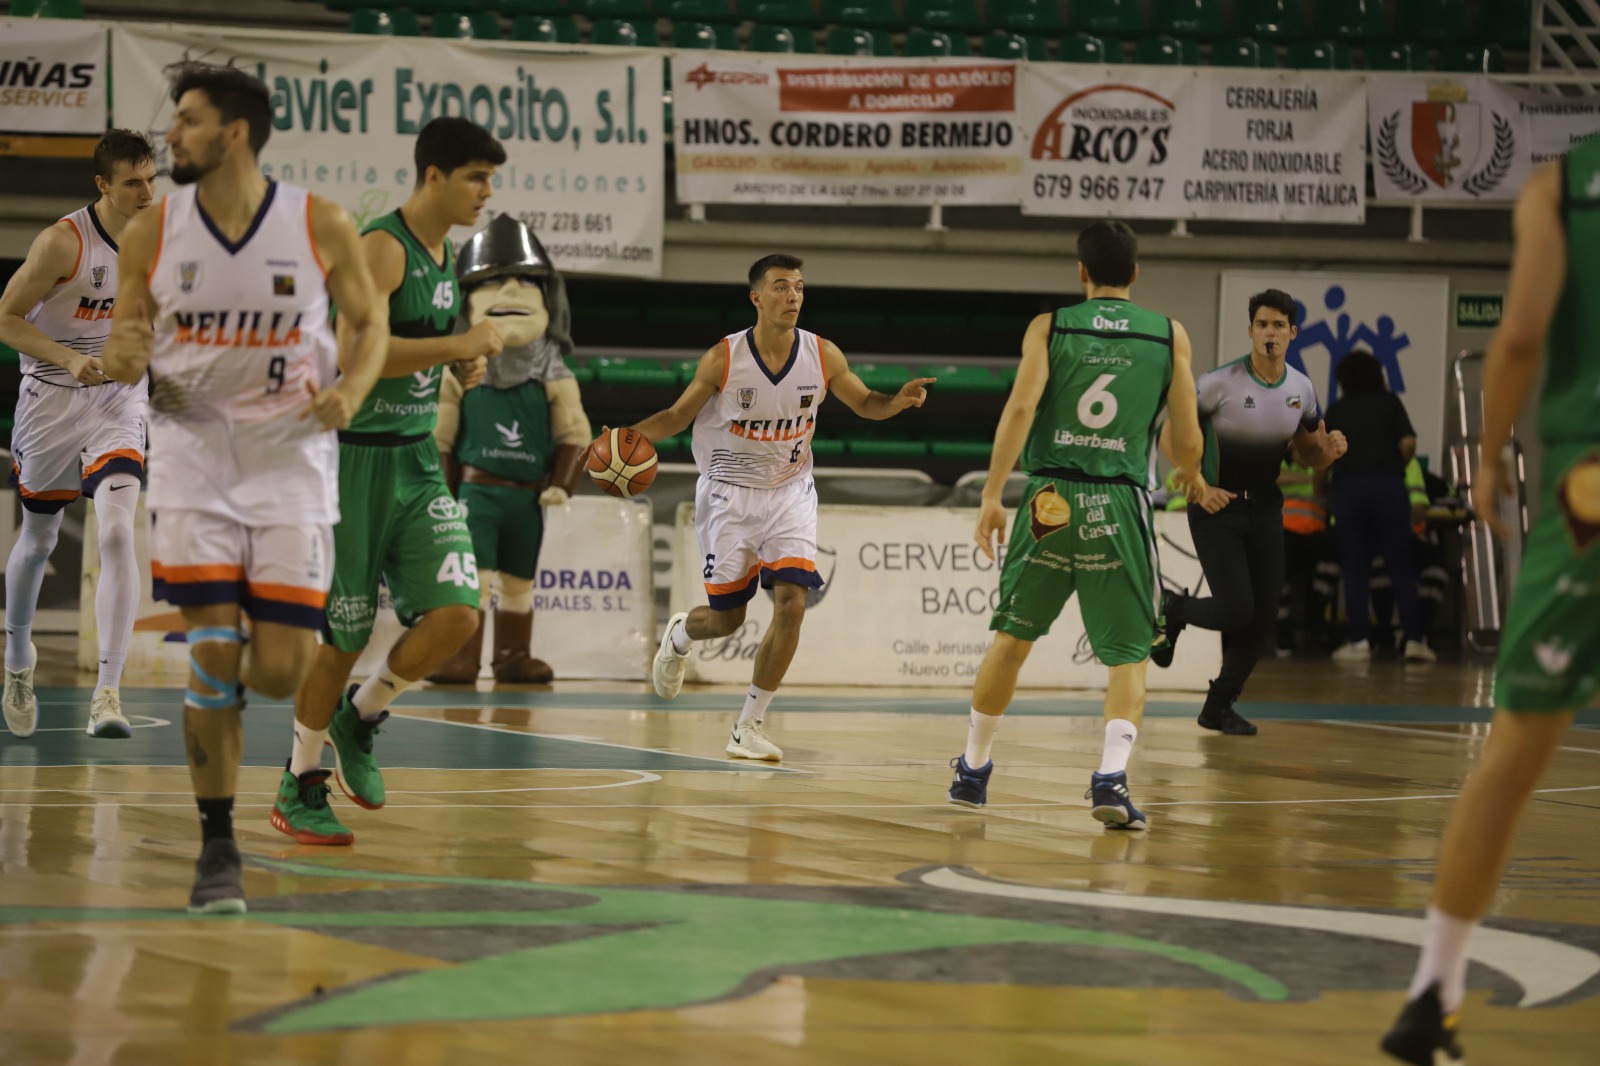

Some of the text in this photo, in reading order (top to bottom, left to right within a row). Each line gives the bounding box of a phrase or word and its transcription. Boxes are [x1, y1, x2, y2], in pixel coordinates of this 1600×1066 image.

[908, 73, 931, 89] DE
[1, 89, 88, 107] SERVICE
[596, 65, 648, 143] s.l.
[849, 95, 861, 108] A
[1072, 107, 1169, 122] INOXIDABLES
[684, 119, 1013, 147] HNOS. CORDERO BERMEJO
[1246, 119, 1294, 142] FORJA
[1202, 149, 1343, 175] ACERO INOXIDABLE
[1033, 174, 1165, 201] 679 966 747
[552, 213, 581, 233] 278
[585, 214, 613, 233] 661
[432, 280, 454, 309] 45
[1459, 302, 1501, 321] SALIDA
[174, 309, 302, 348] MELILLA
[266, 356, 286, 394] 9
[1077, 374, 1118, 429] 6
[729, 413, 814, 441] MELILLA
[1053, 430, 1127, 452] Liberbank
[1076, 492, 1111, 509] Torta
[1086, 507, 1107, 523] del
[1078, 523, 1120, 540] Casar
[436, 551, 480, 590] 45
[602, 596, 631, 611] S.L.
[893, 639, 930, 655] Calle
